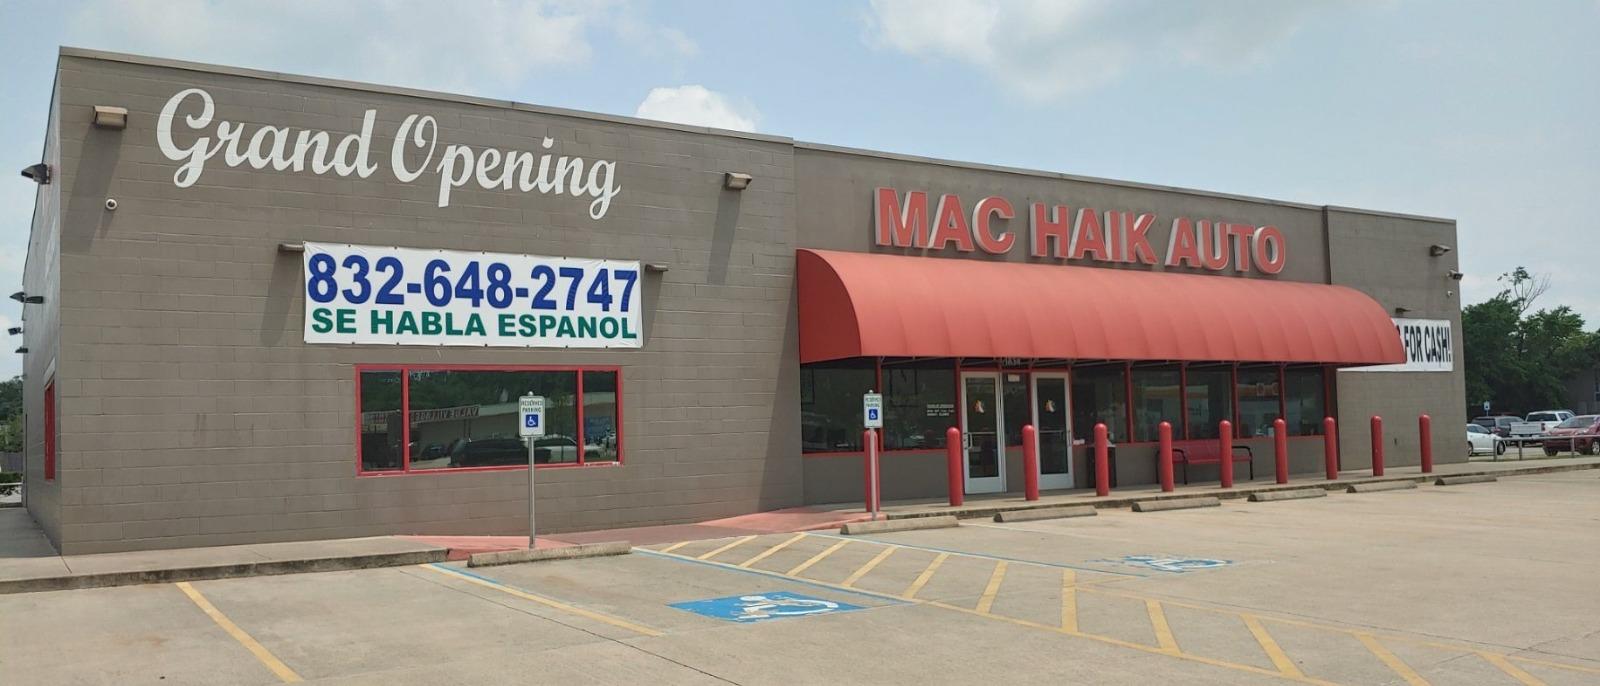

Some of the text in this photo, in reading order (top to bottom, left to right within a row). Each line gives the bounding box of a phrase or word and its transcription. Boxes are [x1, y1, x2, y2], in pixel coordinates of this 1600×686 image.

[156, 88, 621, 220] Grand Opening
[874, 187, 1286, 273] MAC HAIK AUTO
[307, 252, 638, 313] 832-648-2747
[312, 308, 637, 340] SE HABLA ESPANOL
[1404, 326, 1452, 370] FOR CASH!
